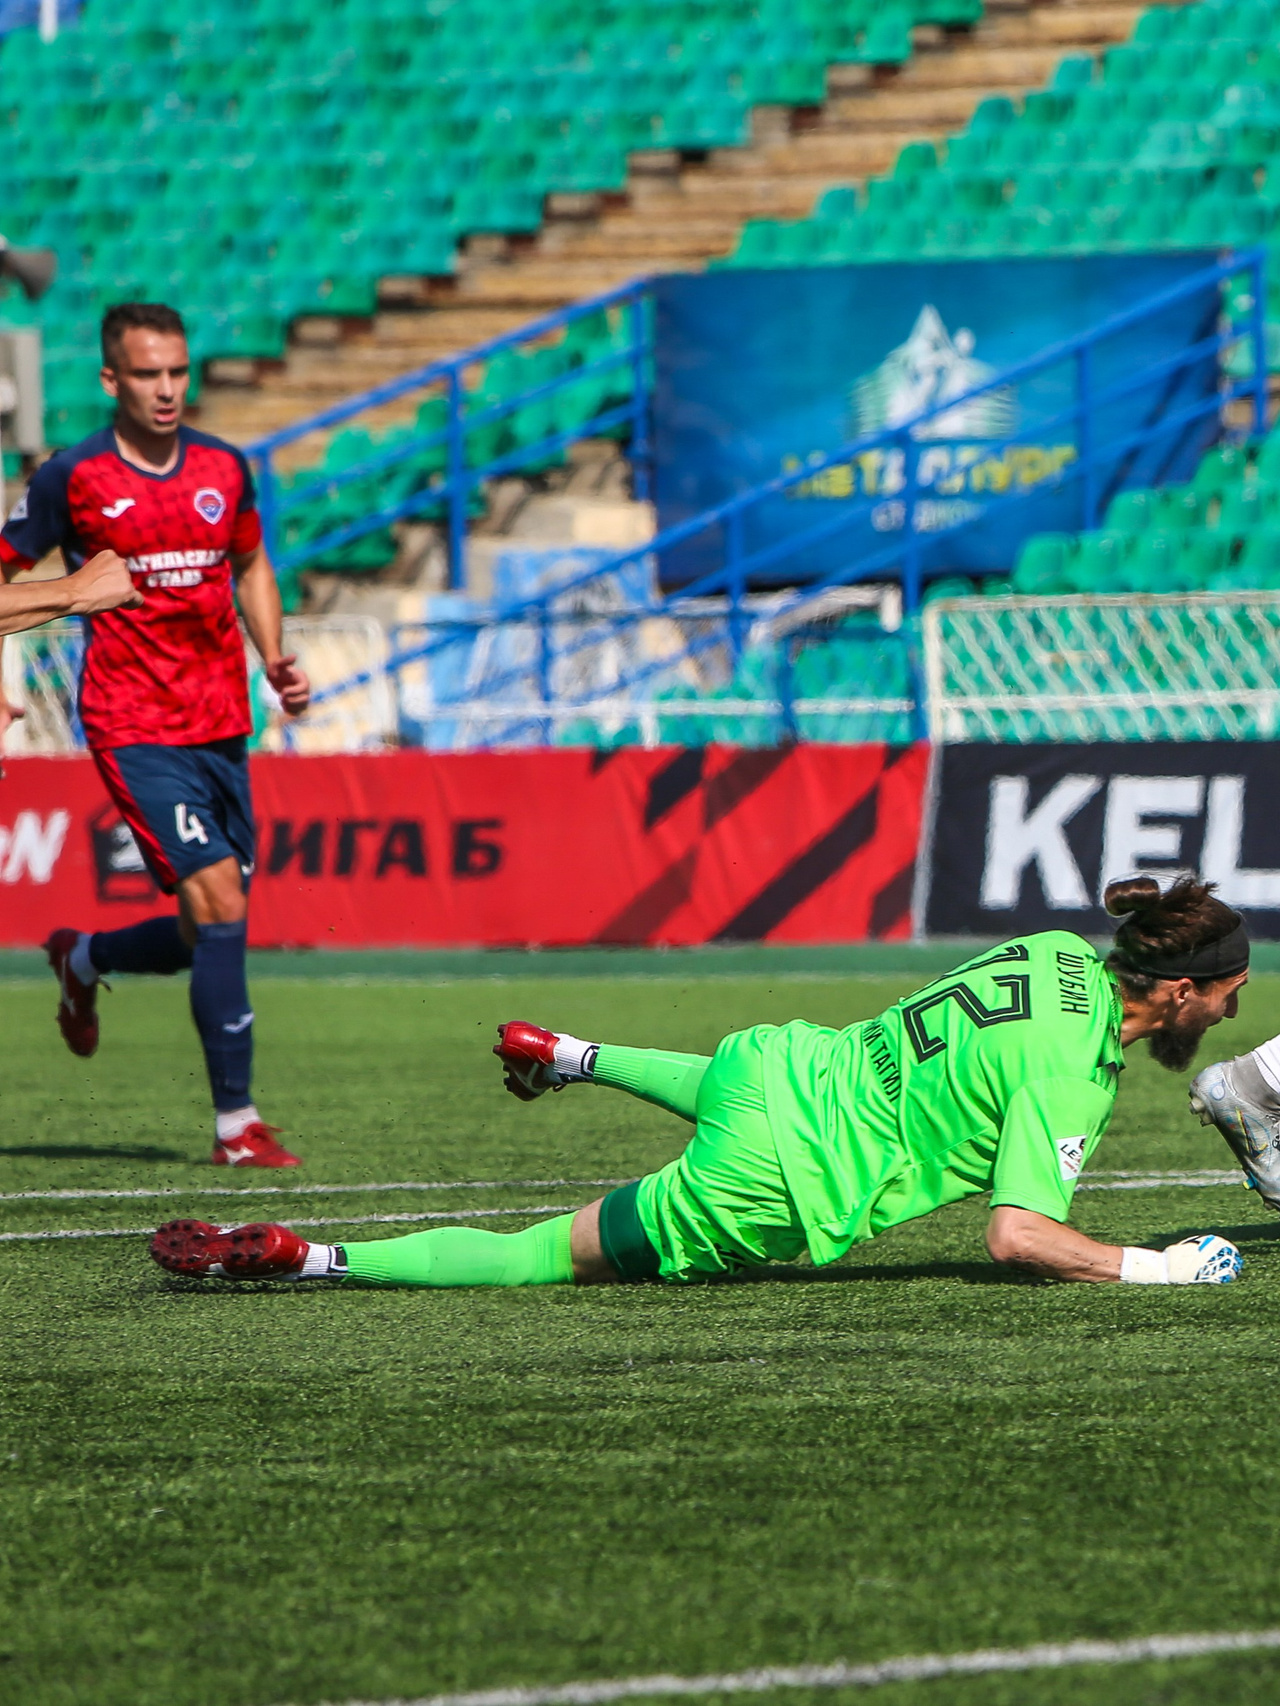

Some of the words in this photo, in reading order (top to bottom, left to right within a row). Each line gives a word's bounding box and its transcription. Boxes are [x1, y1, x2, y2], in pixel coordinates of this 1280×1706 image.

[174, 802, 208, 844] 4
[256, 815, 428, 880] ИГА
[451, 816, 509, 881] Б
[1056, 951, 1090, 1015] ШУБИН
